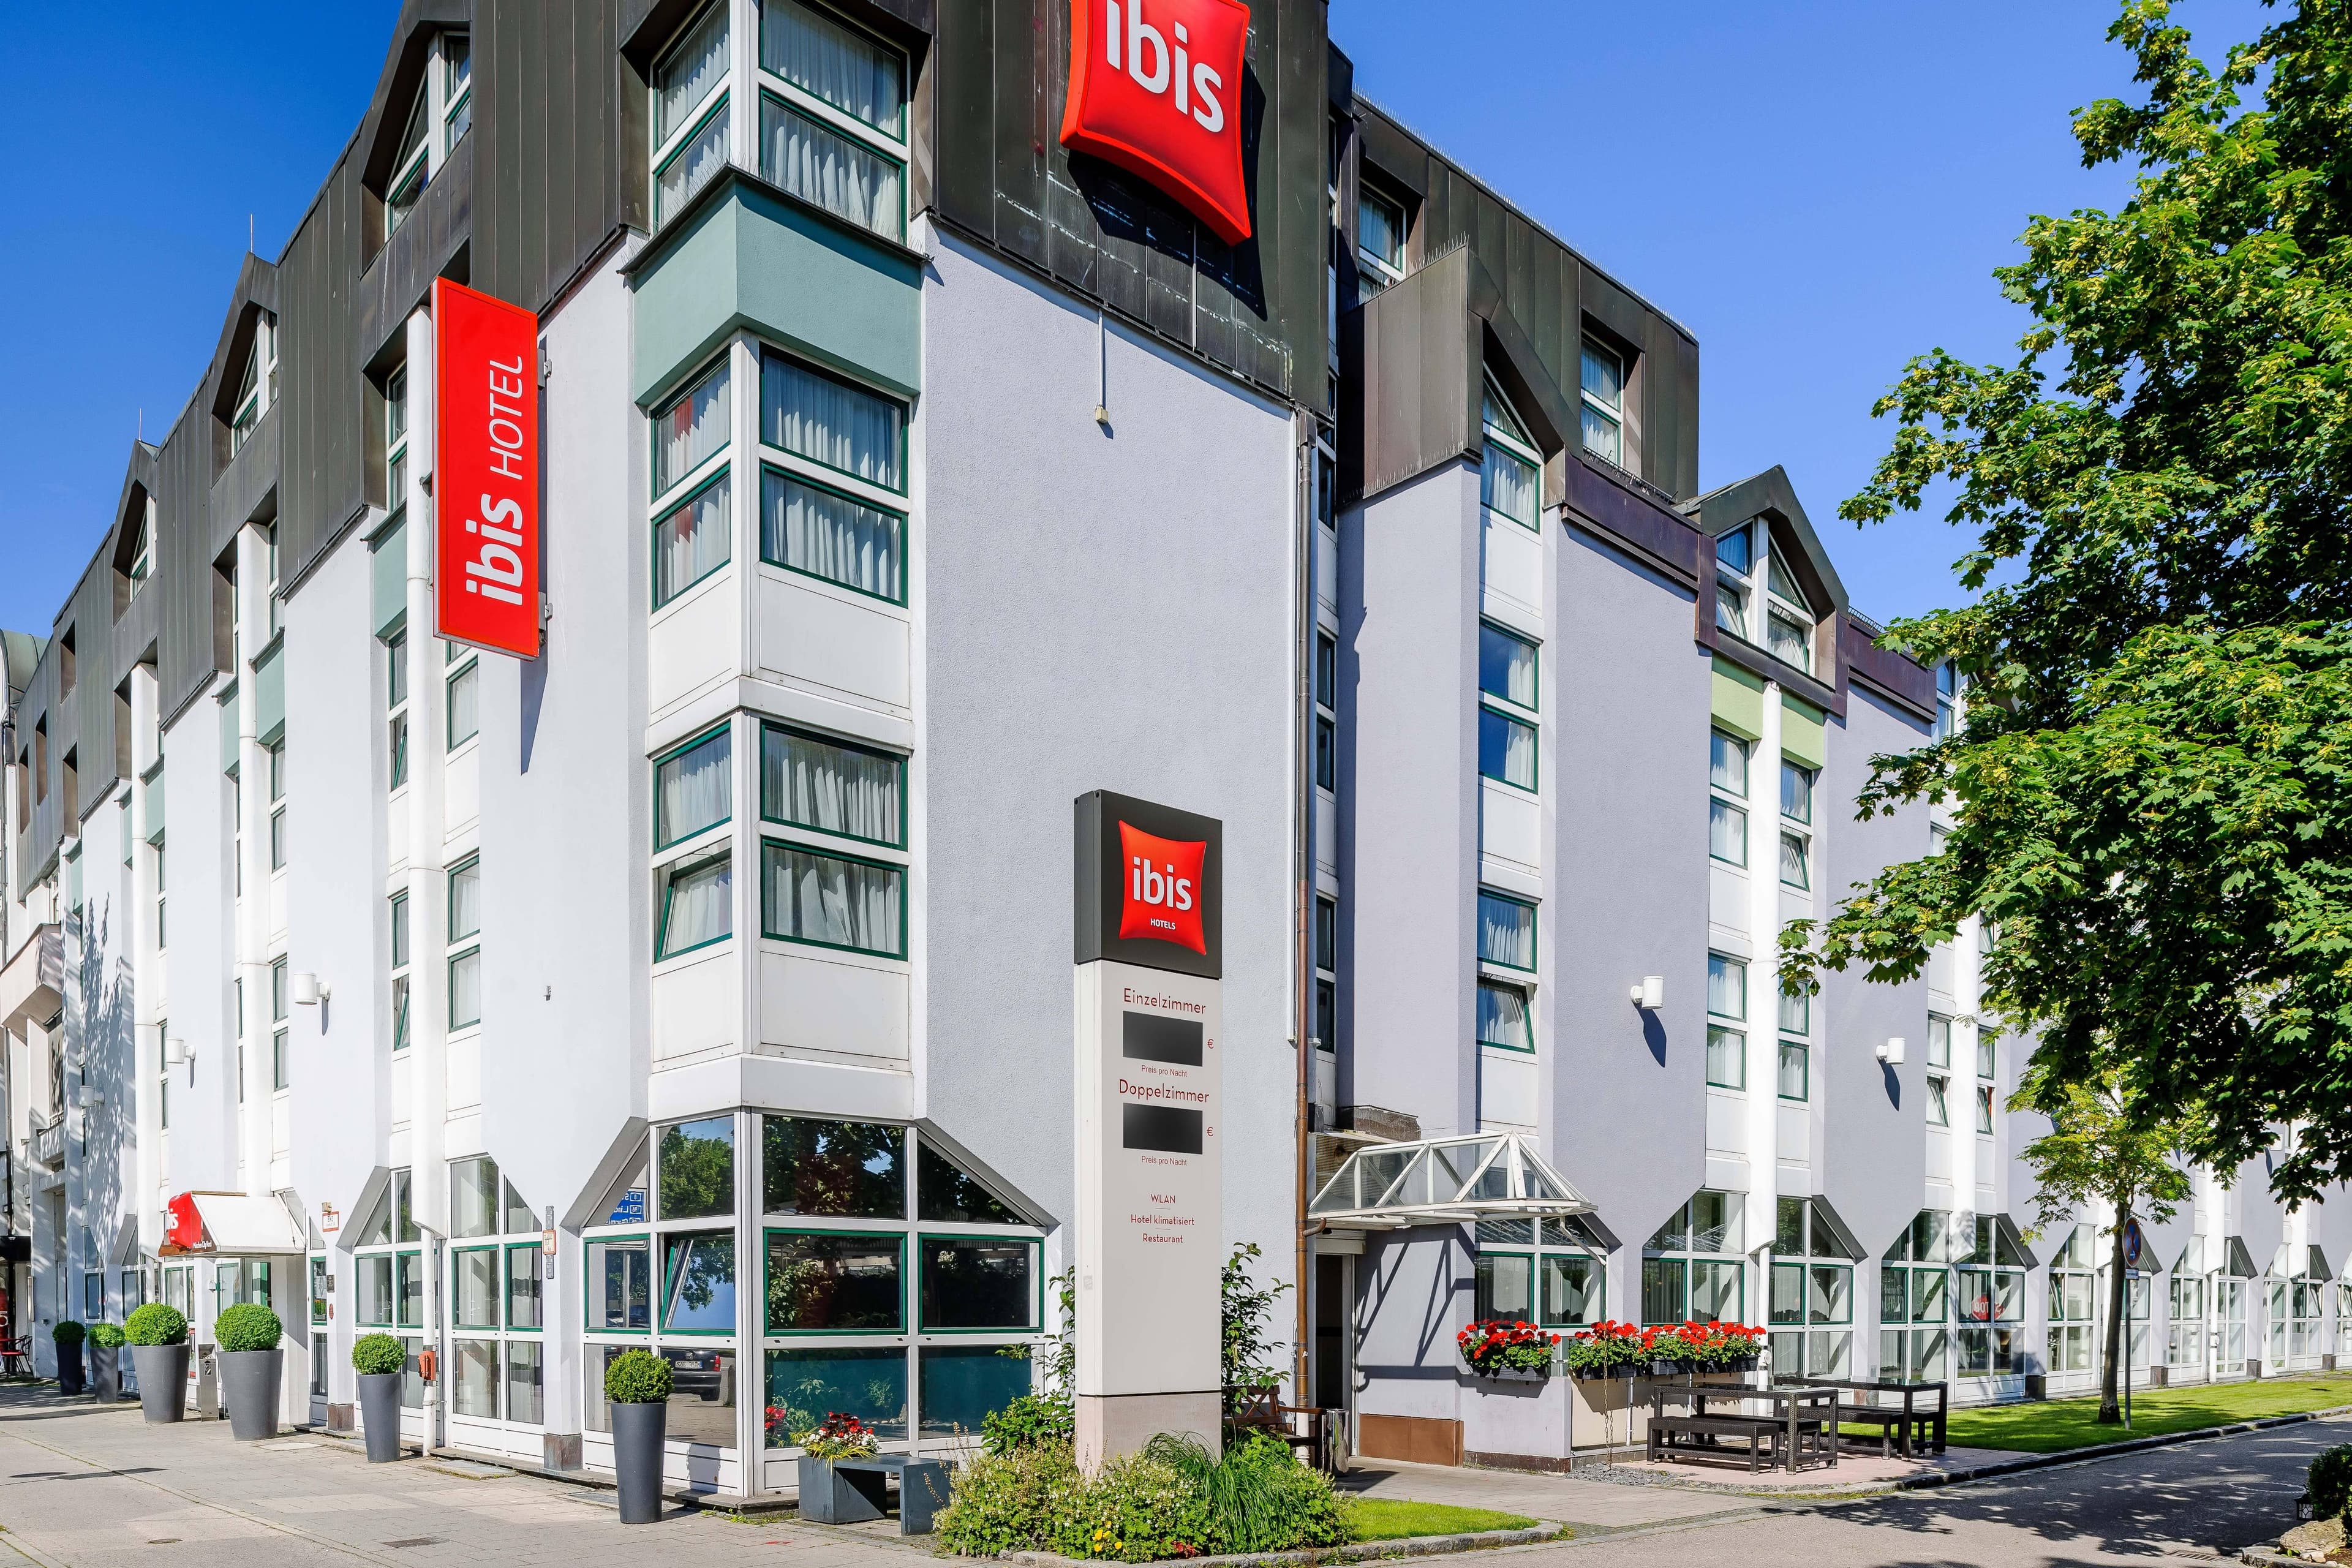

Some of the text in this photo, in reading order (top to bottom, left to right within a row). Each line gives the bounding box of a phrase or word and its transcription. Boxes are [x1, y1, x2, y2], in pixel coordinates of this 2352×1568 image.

[1107, 0, 1224, 133] ibis
[465, 355, 523, 606] ibis HOTEL
[1133, 856, 1193, 911] ibis
[1150, 918, 1176, 930] HOTELS
[1123, 987, 1206, 1014] Einzelzimmer
[1207, 1038, 1214, 1049] €
[1141, 1065, 1188, 1078] Preis pro Nacht
[1119, 1079, 1209, 1103] Doppelzimmer
[1207, 1126, 1214, 1137] €
[1141, 1155, 1188, 1167] Preis pro Nacht
[1150, 1194, 1176, 1204] WLAN
[1131, 1214, 1195, 1226] Hotel klimatisiert
[1143, 1233, 1183, 1243] Restaurant
